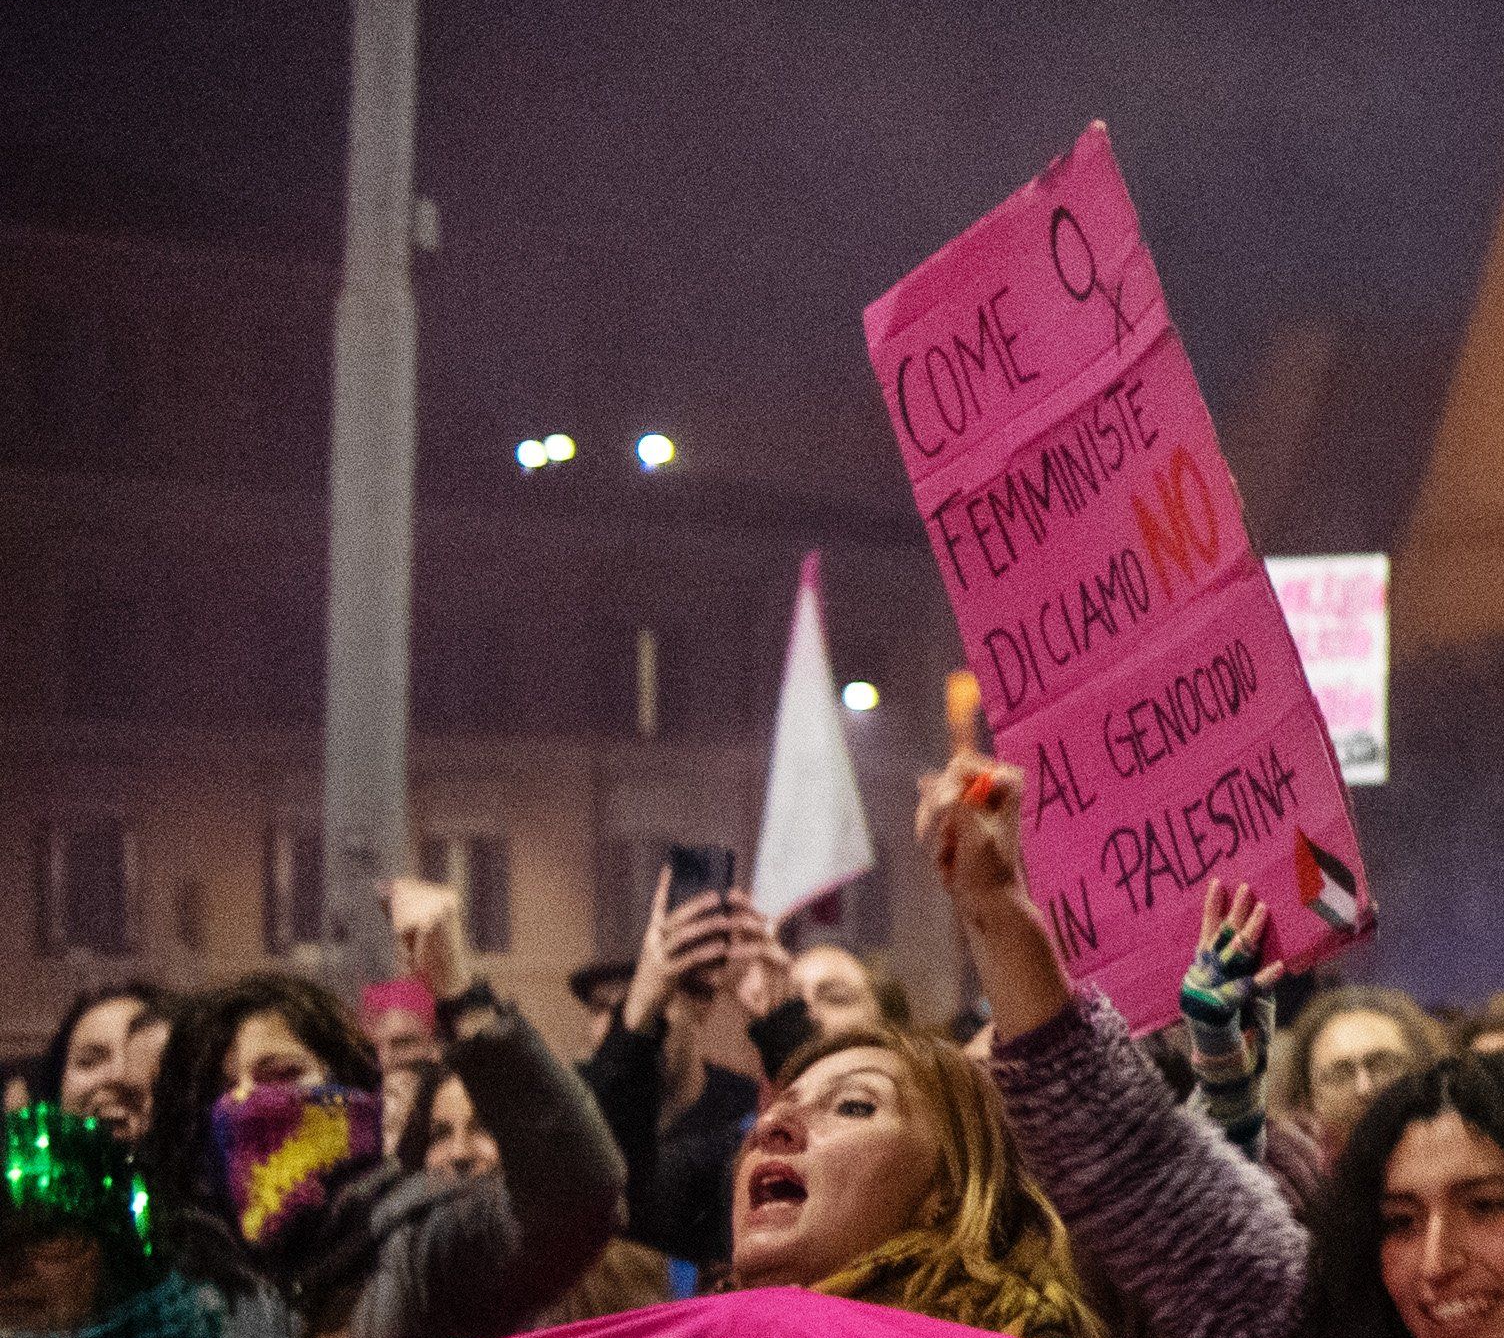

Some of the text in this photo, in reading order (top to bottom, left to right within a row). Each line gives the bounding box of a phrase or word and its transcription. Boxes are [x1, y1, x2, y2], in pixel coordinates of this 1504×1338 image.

[897, 287, 1041, 459] COME
[929, 377, 1161, 591] FEMMINISTE
[982, 443, 1222, 711] DICIAMO NO
[1035, 637, 1258, 831] AL GENOCIDIO
[1048, 745, 1298, 965] IN PALESTINA
